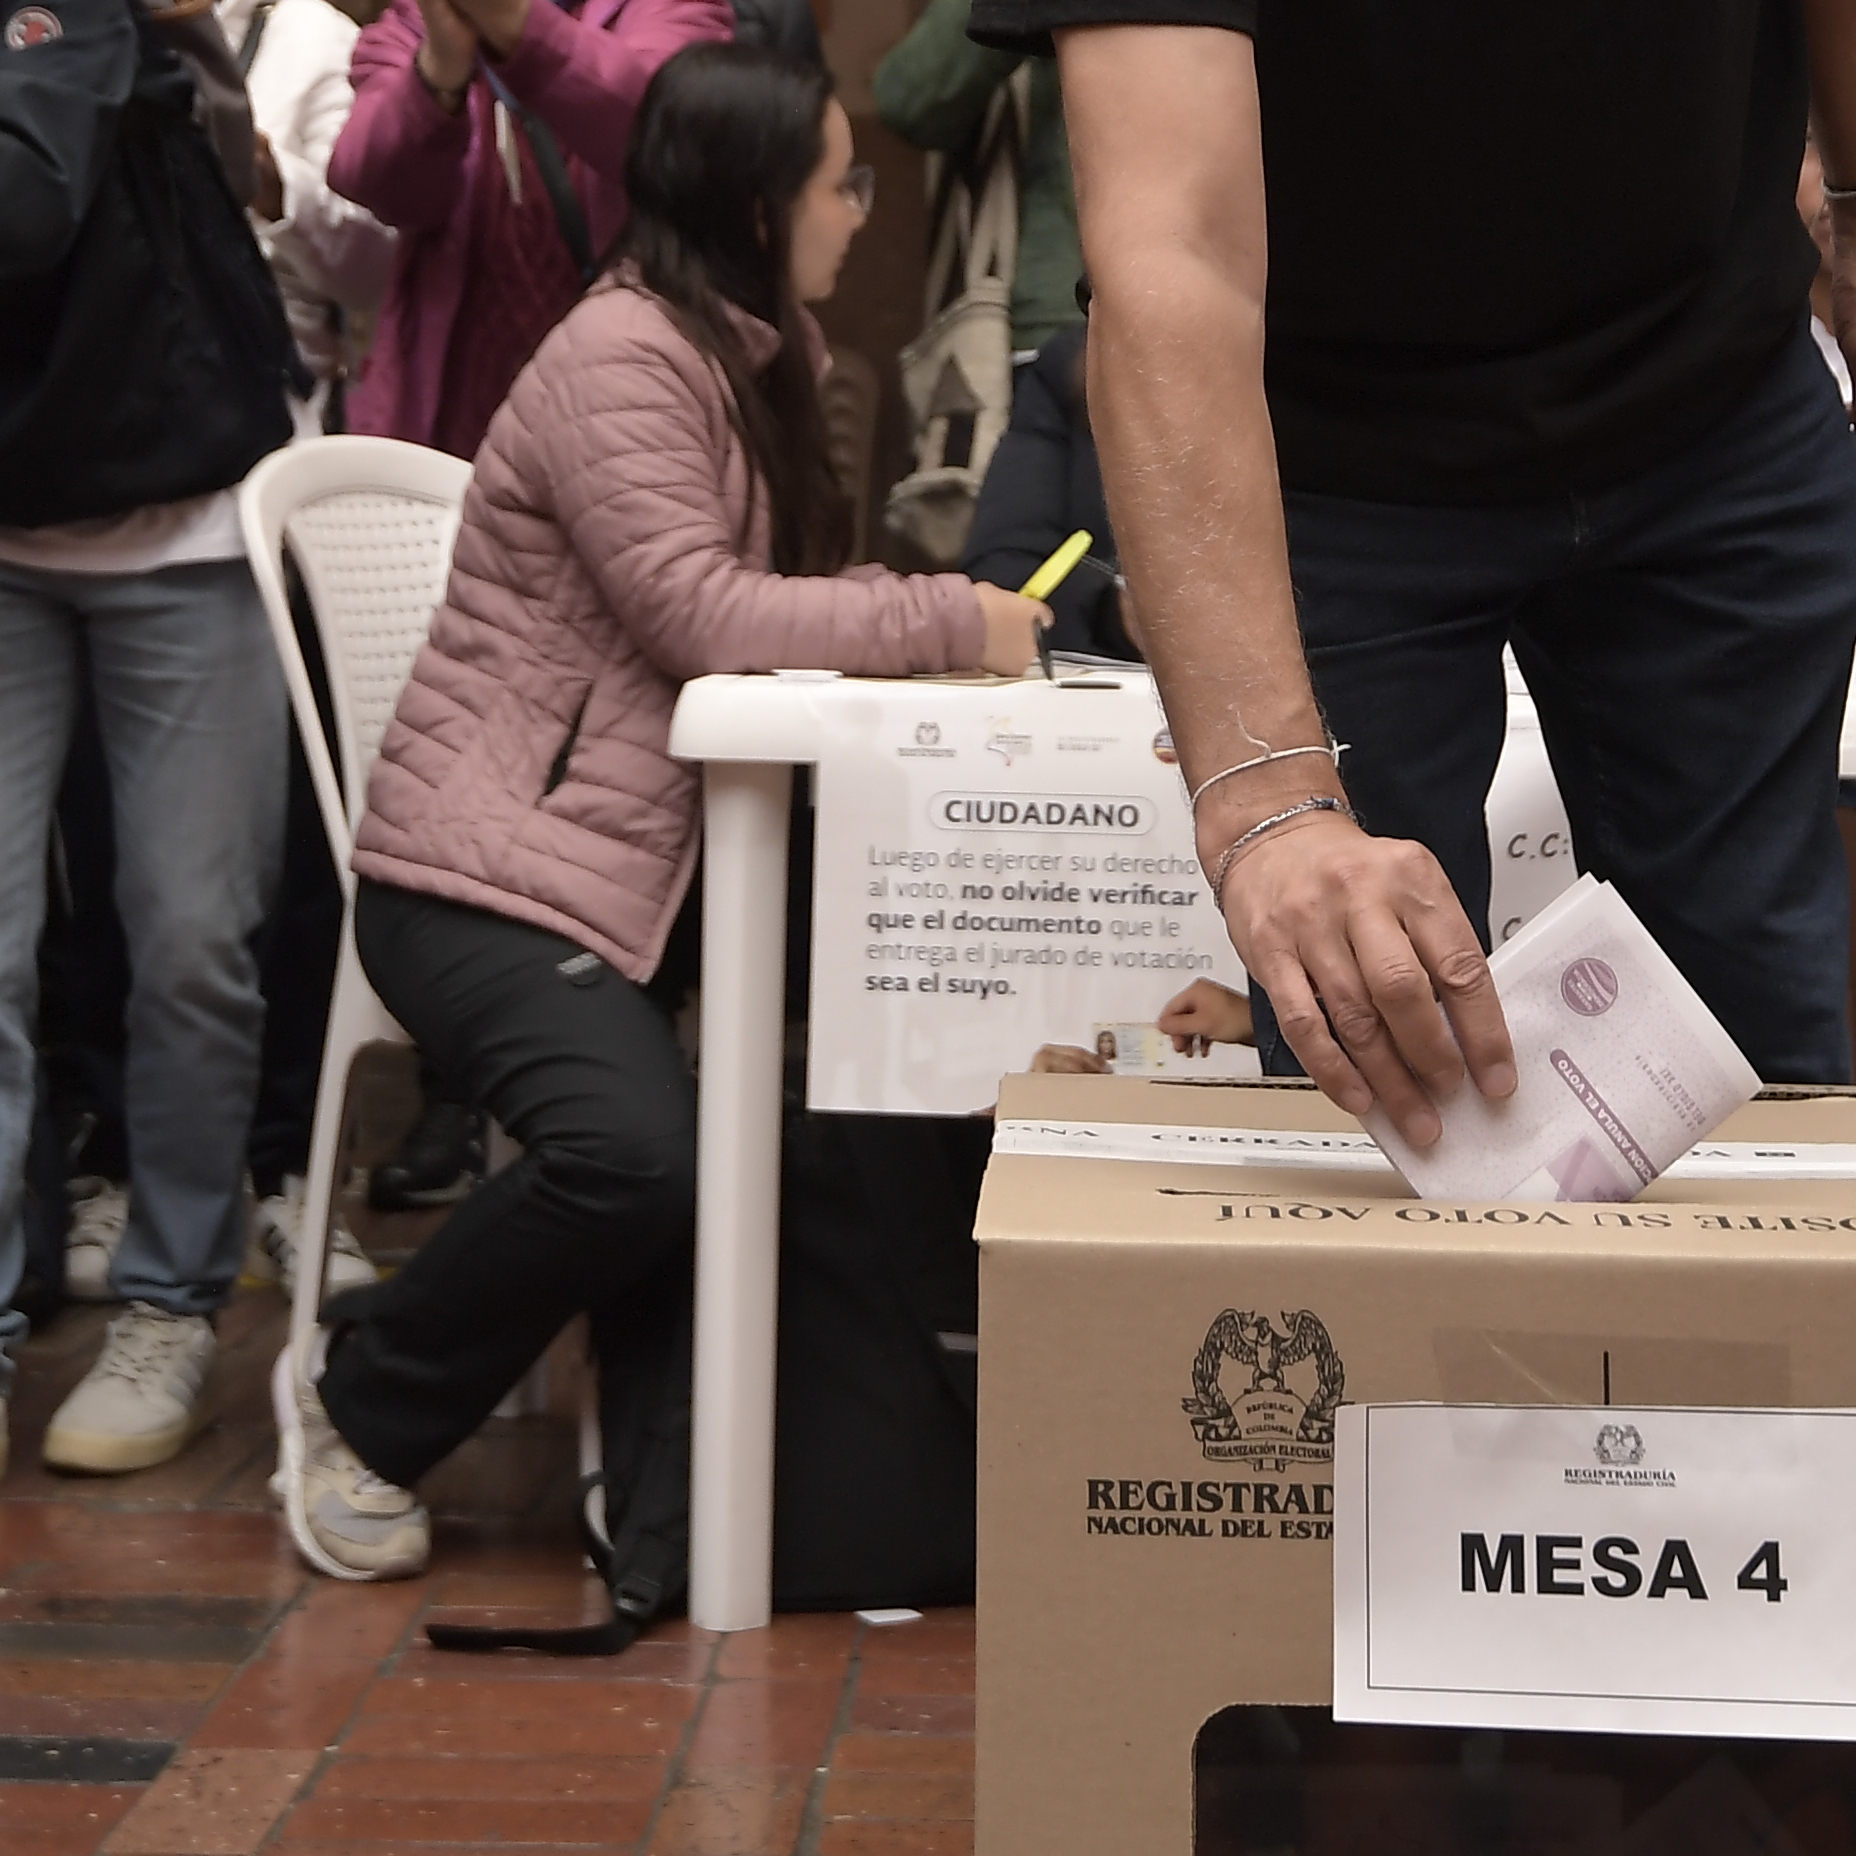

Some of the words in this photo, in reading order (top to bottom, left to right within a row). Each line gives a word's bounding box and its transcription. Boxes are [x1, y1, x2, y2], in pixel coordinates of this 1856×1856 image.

[944, 799, 1140, 828] CIUDADANO
[867, 845, 939, 873] Luego
[946, 847, 975, 869] de
[982, 848, 1063, 878] ejercer
[1070, 854, 1098, 872] su
[1103, 851, 1199, 876] derecho
[867, 877, 889, 897] al
[960, 883, 994, 901] no
[1001, 879, 1082, 903] olvide
[1088, 882, 1200, 908] verificar
[867, 912, 915, 934] que
[923, 910, 945, 931] el
[952, 910, 1102, 936] documento
[1109, 917, 1153, 943] que
[1159, 916, 1181, 938] le
[867, 944, 959, 971] entrega
[965, 942, 986, 964] el
[989, 943, 1067, 971] jurado
[1075, 945, 1104, 967] de
[1111, 945, 1214, 971] votación
[865, 974, 910, 993] sea
[917, 971, 941, 994] el
[946, 977, 1018, 1001] suyo.
[1556, 1058, 1588, 1094] VOTO
[1582, 1090, 1601, 1111] EL
[1596, 1108, 1633, 1151] ANULA
[1217, 1202, 1373, 1224] AQUÍ
[1394, 1205, 1572, 1227] VOTO
[1593, 1211, 1673, 1230] SU
[1245, 1424, 1294, 1437] COLOMBIA
[1207, 1441, 1276, 1457] ORGANIZACIÓN
[1278, 1444, 1331, 1460] ELECTORAL
[1564, 1467, 1676, 1481] REGISTRADURÍA
[1087, 1516, 1213, 1538] NACIONAL
[1221, 1518, 1272, 1539] DEL
[1460, 1531, 1709, 1601] MESA
[1737, 1540, 1788, 1603] 4
